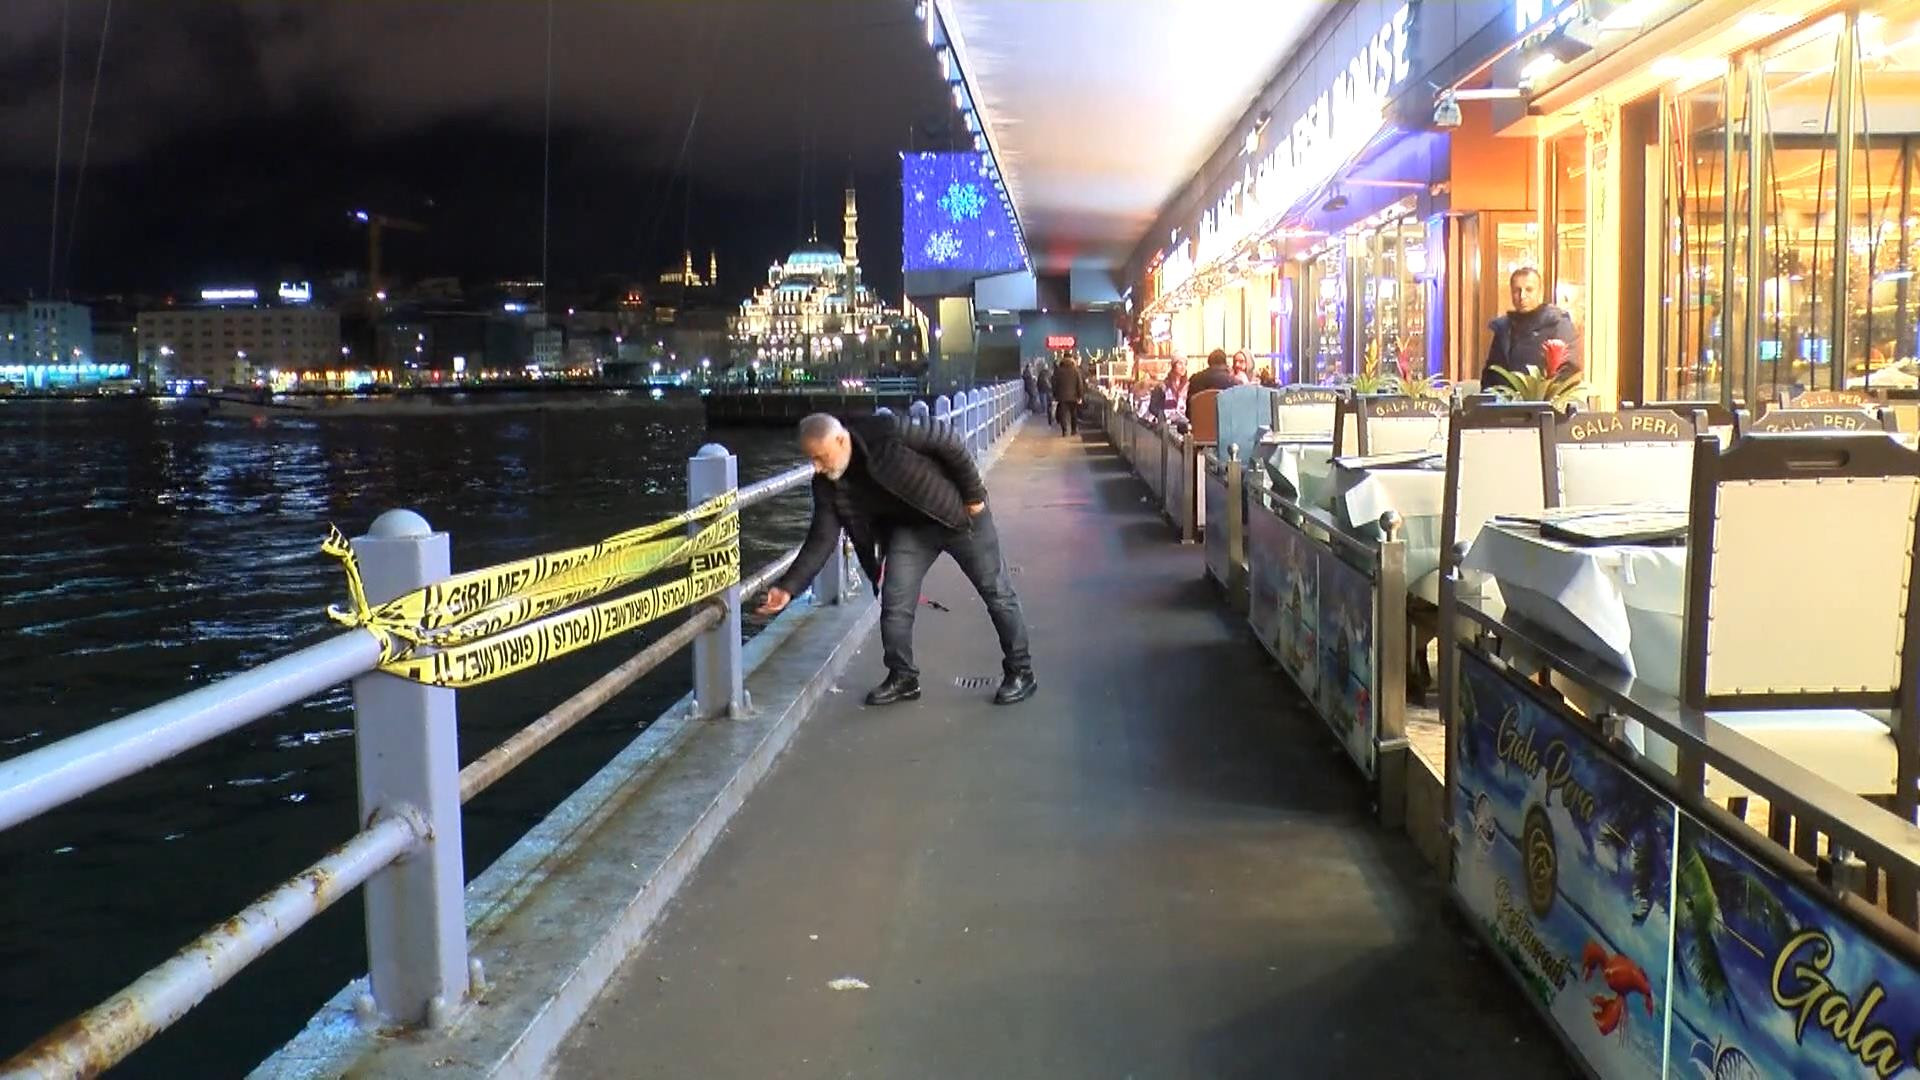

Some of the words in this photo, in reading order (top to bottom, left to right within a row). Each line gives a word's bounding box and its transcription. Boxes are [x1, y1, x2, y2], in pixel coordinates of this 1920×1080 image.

[1571, 417, 1623, 440] GALA
[1631, 416, 1680, 437] PERA
[1772, 931, 1903, 1079] Gala
